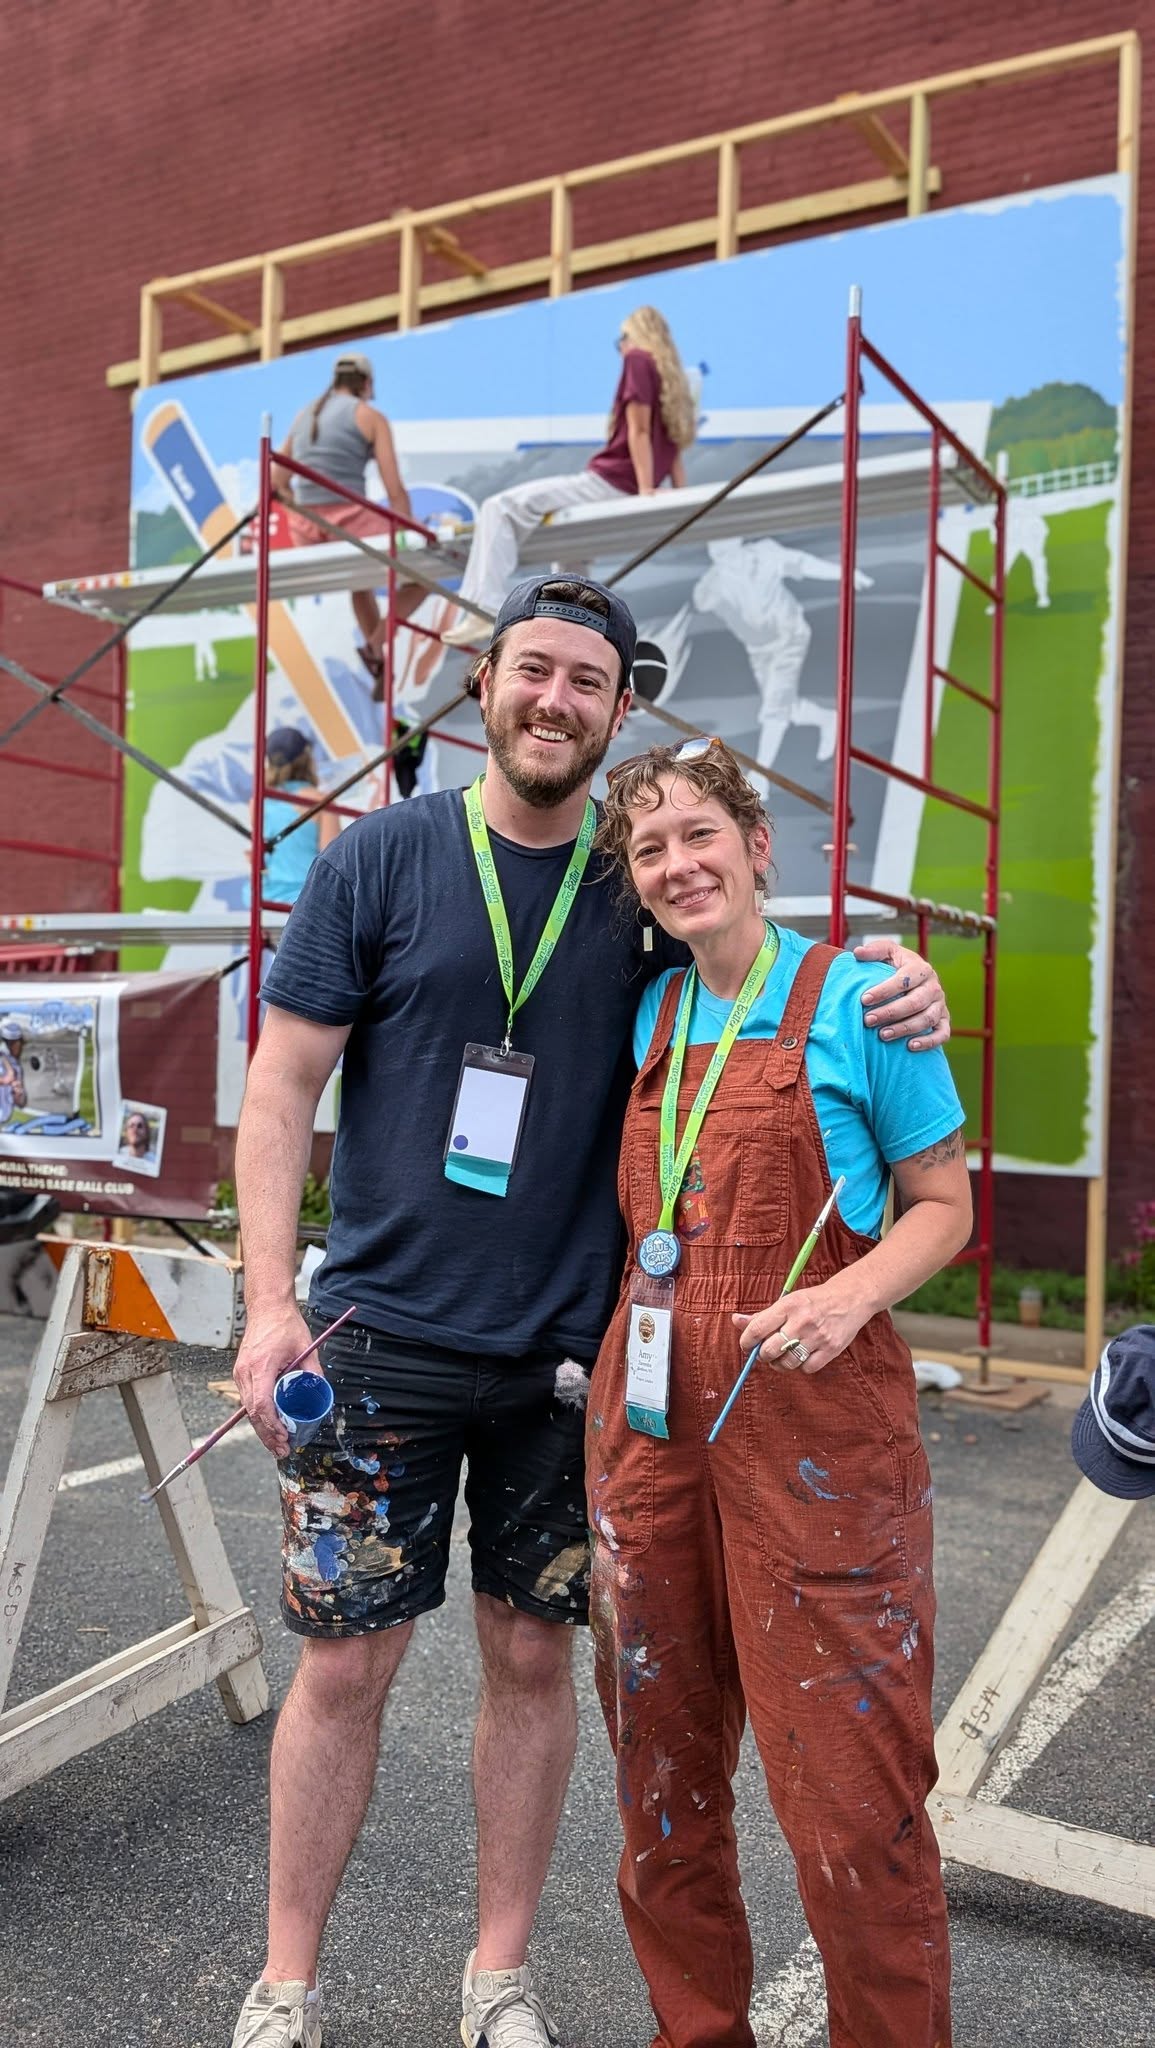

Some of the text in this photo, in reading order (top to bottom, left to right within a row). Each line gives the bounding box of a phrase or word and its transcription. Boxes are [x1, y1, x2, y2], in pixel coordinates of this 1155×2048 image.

[481, 851, 500, 904] WESTconsin
[556, 864, 581, 922] Inspiring Better!
[495, 923, 512, 990] Inspiring Better!
[522, 938, 551, 993] WESTconsin
[728, 968, 761, 1033] Inspiring Better!
[668, 1056, 681, 1084] Better!
[696, 1054, 726, 1115] WESTconsin
[675, 1136, 691, 1174] Inspiring
[76, 1181, 102, 1193] BALL
[104, 1182, 134, 1195] CLUB
[646, 1239, 670, 1253] BLUE
[646, 1252, 672, 1267] CAPS
[638, 1349, 652, 1362] Amy
[960, 1686, 1000, 1740] MSD
